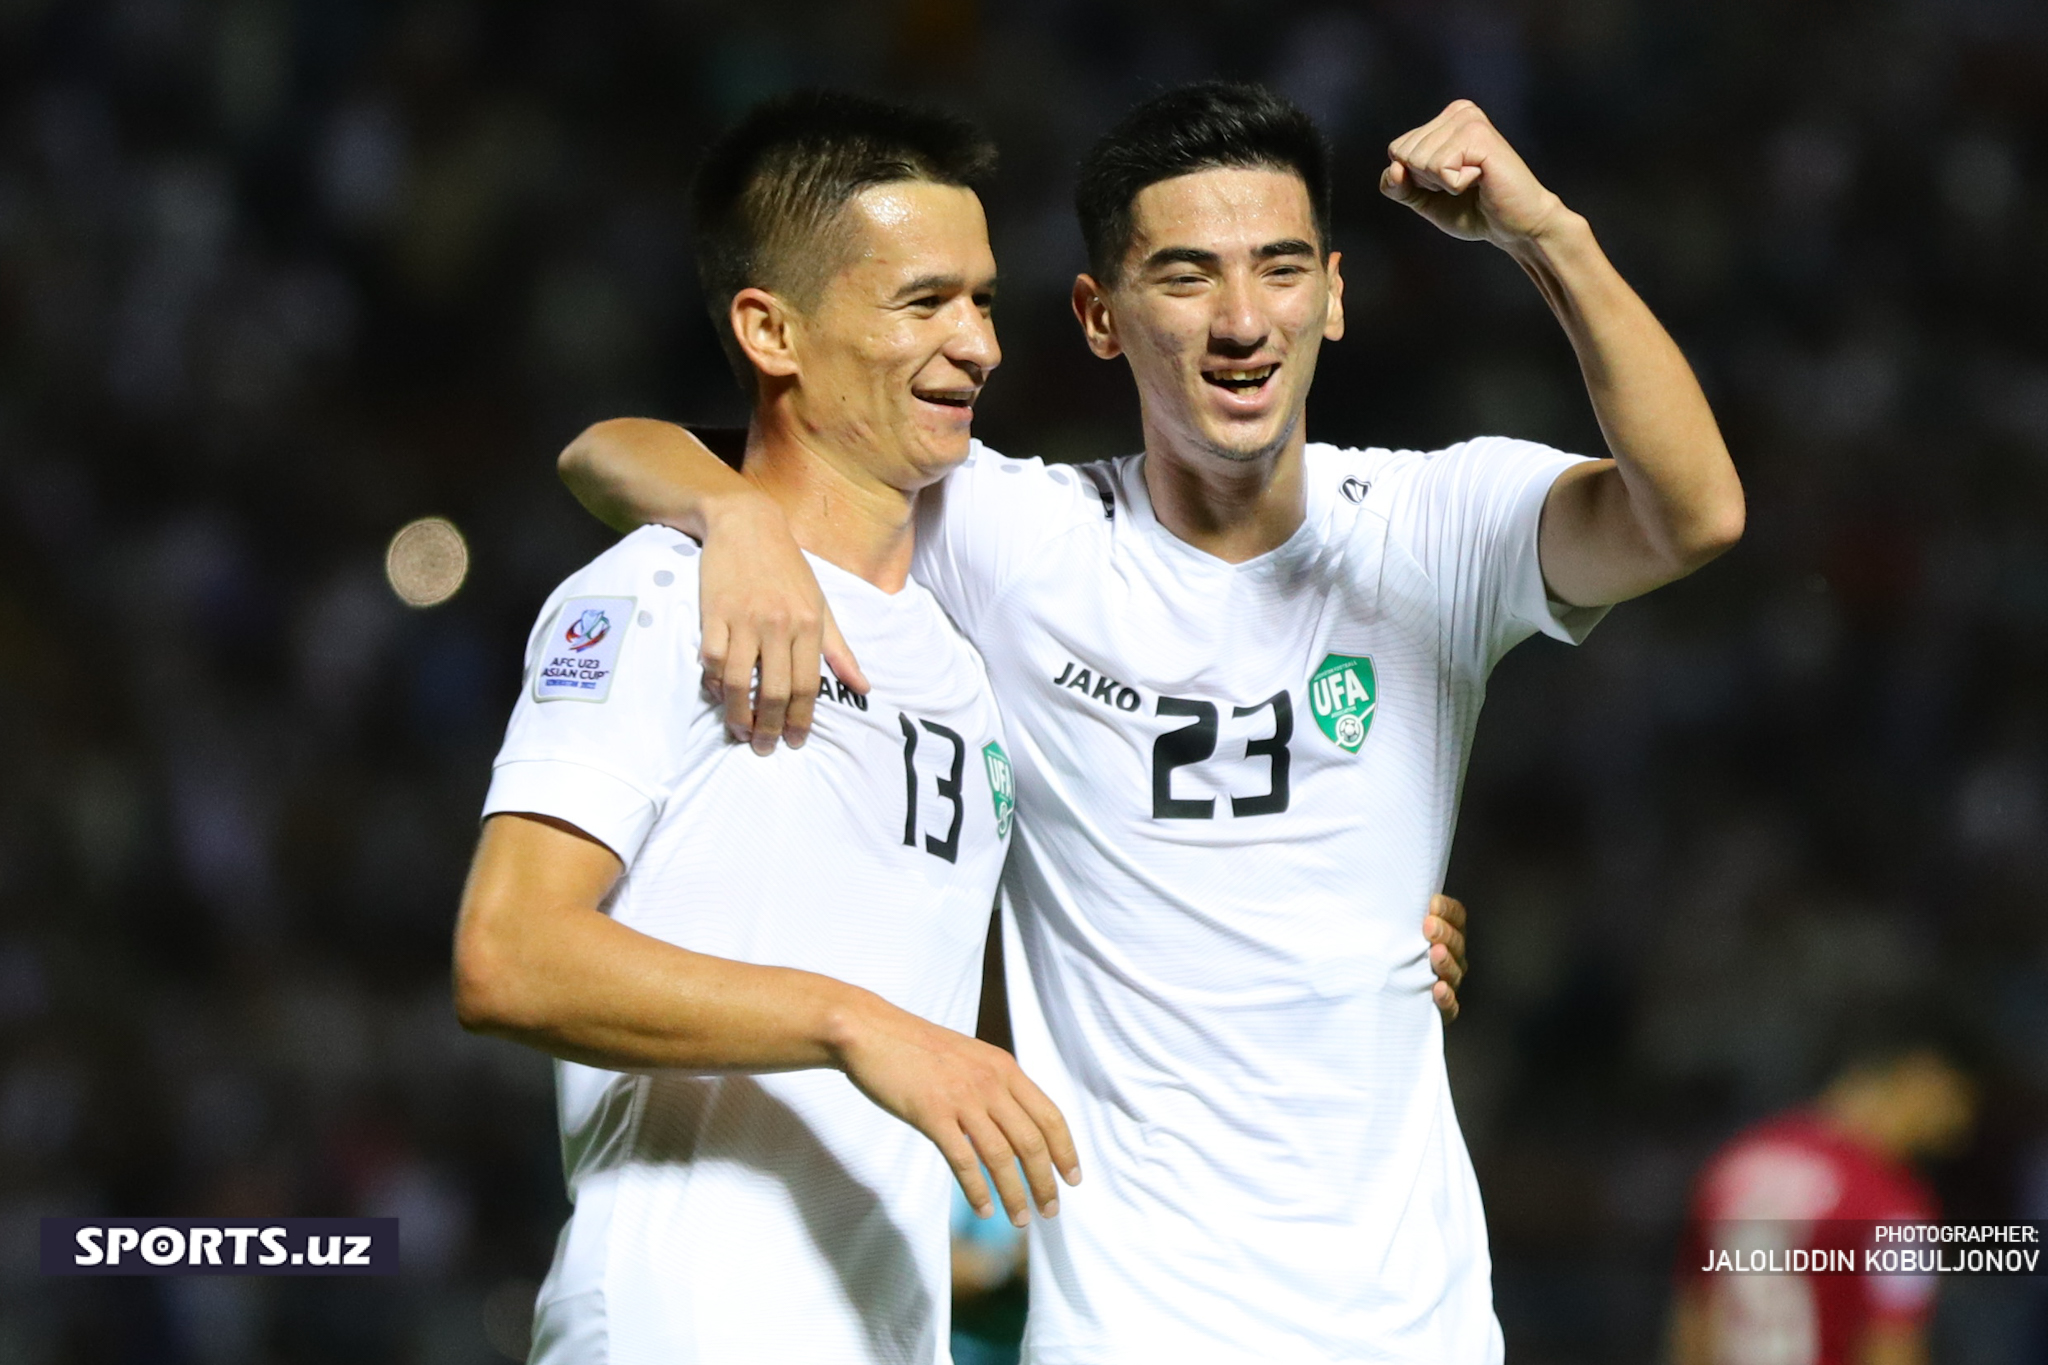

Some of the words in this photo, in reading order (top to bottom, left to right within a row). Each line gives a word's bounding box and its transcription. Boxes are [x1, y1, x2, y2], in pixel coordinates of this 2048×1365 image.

[541, 668, 577, 678] ASIAN
[550, 657, 576, 668] AFC
[577, 659, 600, 669] U23
[1053, 662, 1142, 713] JAKO
[816, 675, 868, 712] AKO
[1313, 668, 1370, 717] UFA
[1152, 689, 1294, 820] 23
[898, 711, 966, 866] 13
